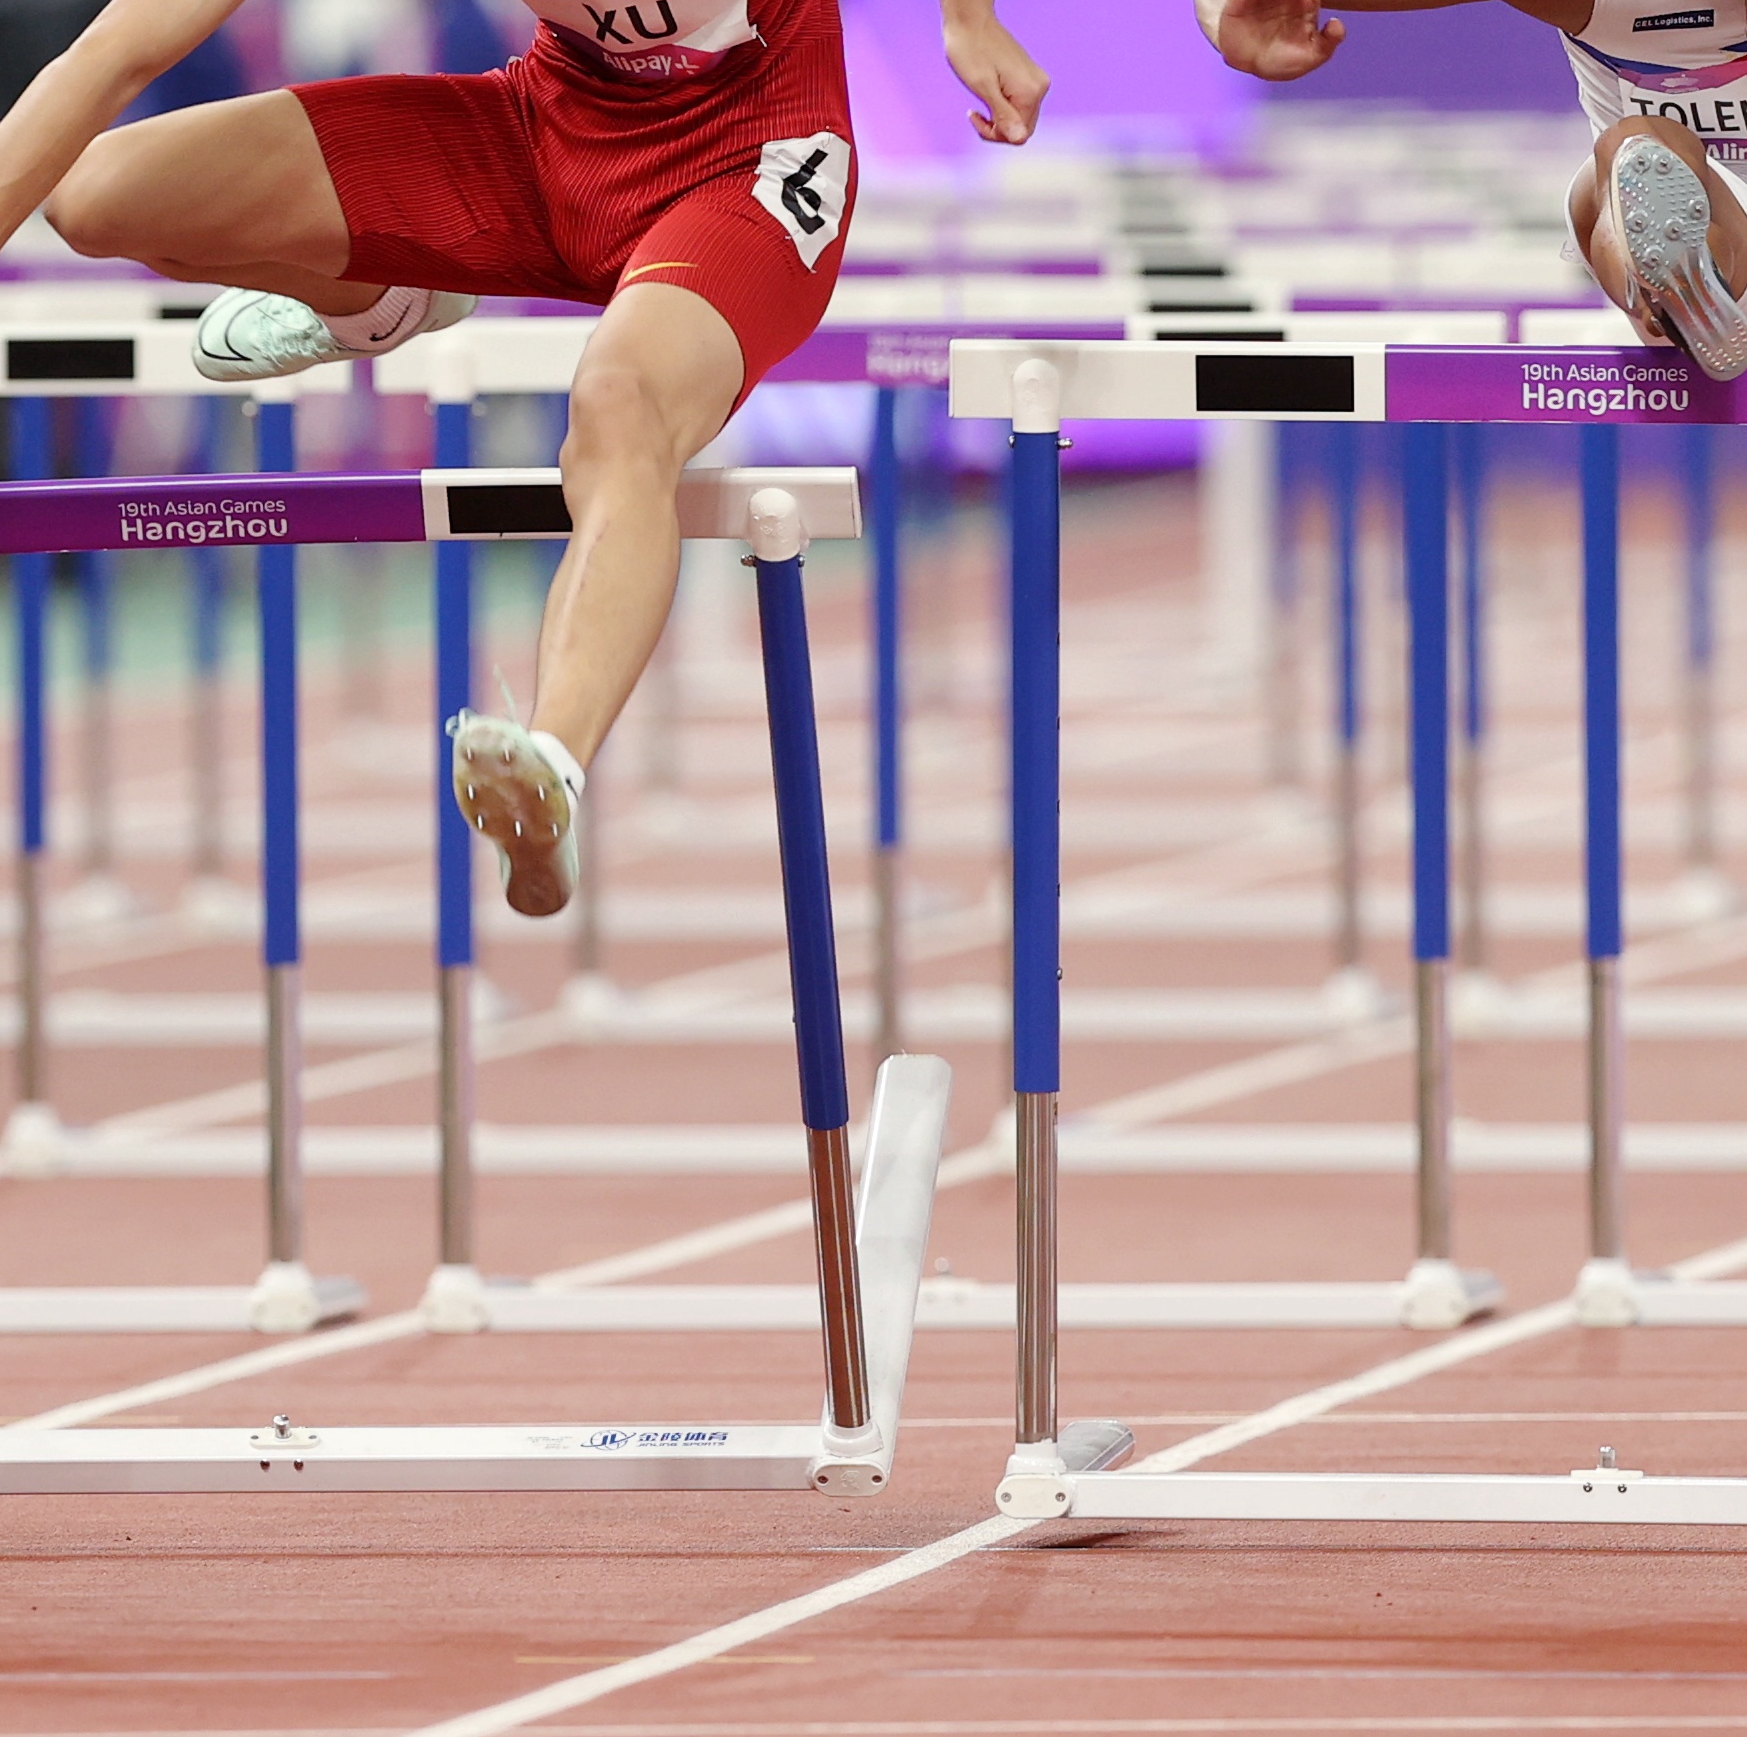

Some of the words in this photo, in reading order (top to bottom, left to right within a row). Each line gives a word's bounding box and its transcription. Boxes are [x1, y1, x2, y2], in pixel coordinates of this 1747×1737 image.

[1655, 16, 1696, 26] Logistics,
[1697, 15, 1713, 23] Inc.
[780, 148, 829, 235] 6
[1520, 363, 1563, 381] 19th
[1566, 363, 1620, 382] Asian
[1622, 364, 1689, 382] Games
[1521, 382, 1690, 416] Hangzhou
[118, 501, 161, 517] 19th
[164, 500, 217, 516] Asian
[220, 499, 286, 514] Games
[120, 515, 288, 544] Hangzhou
